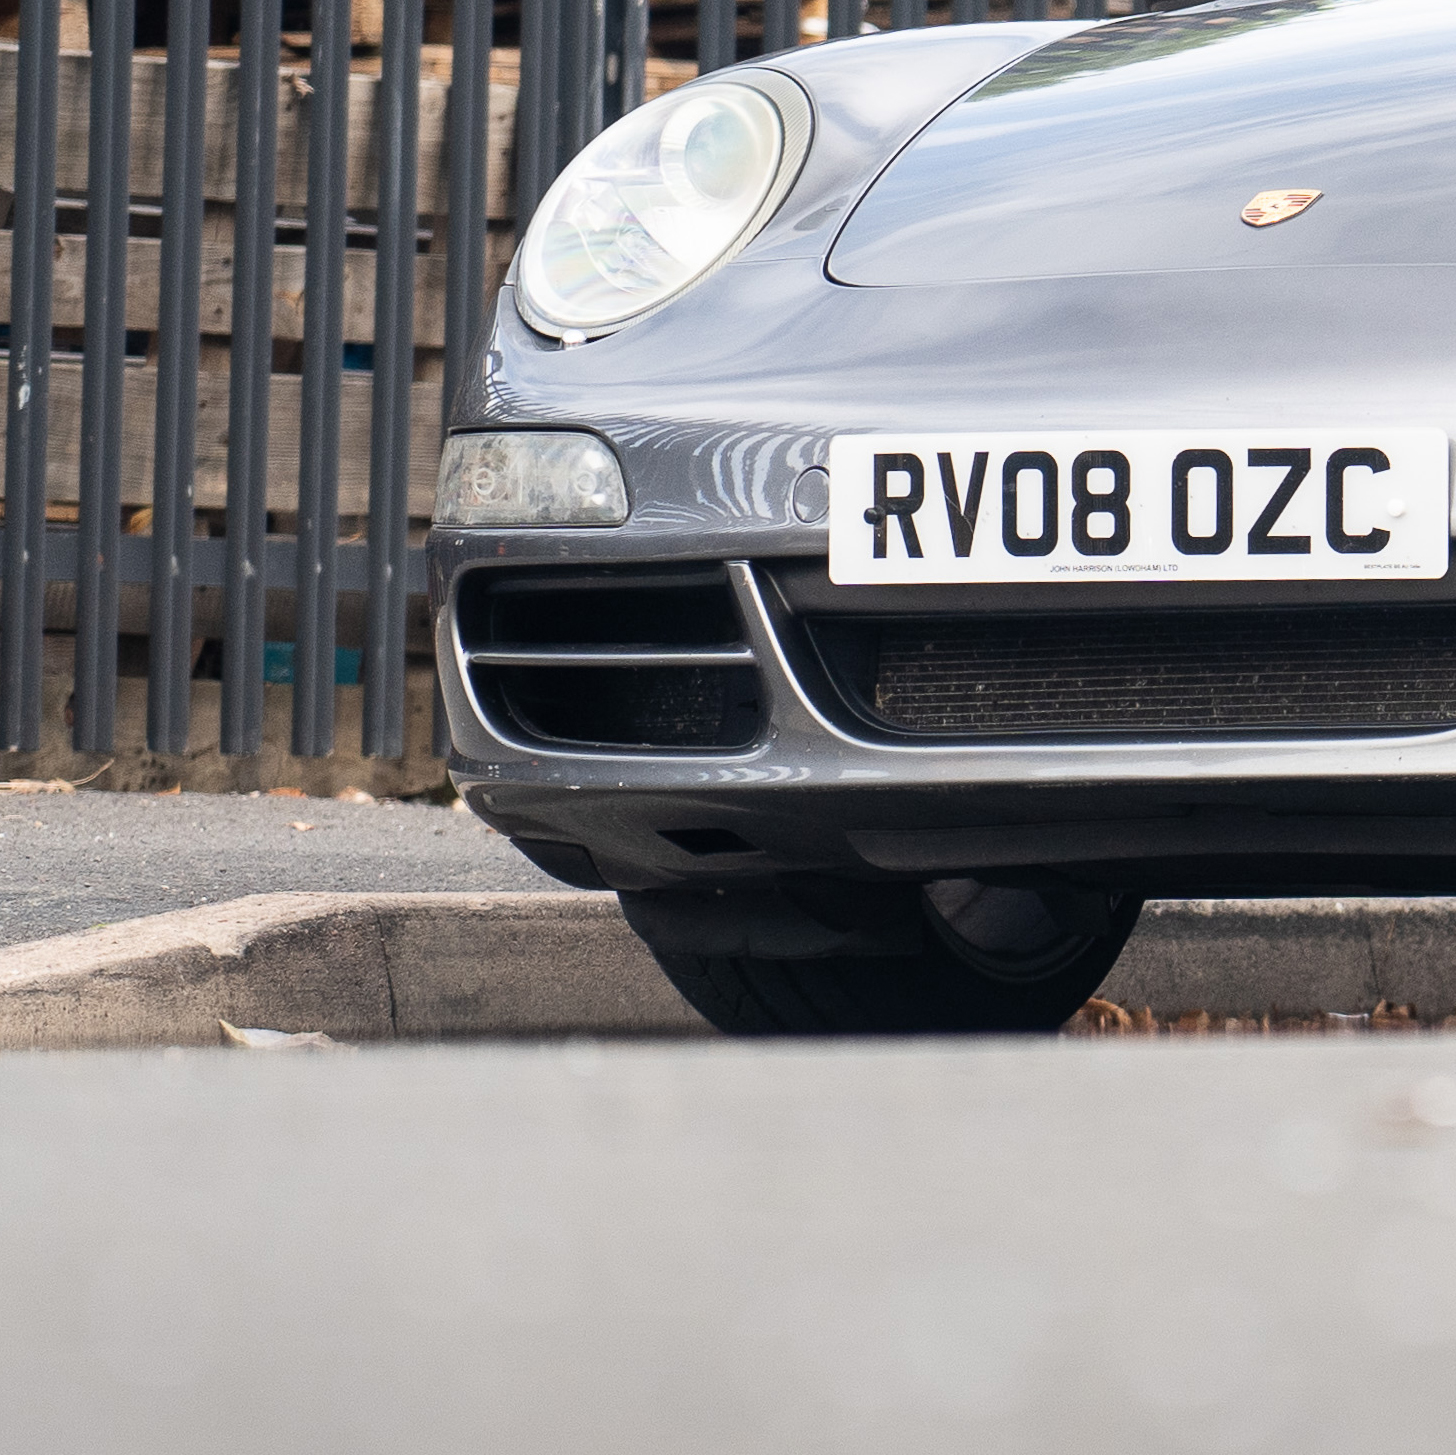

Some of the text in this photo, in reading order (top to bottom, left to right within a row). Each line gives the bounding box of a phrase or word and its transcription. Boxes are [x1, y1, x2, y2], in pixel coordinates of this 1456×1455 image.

[871, 447, 1391, 558] RV08 OZC
[1049, 564, 1071, 573] JOHN
[1072, 564, 1113, 573] HARRISON
[1162, 563, 1179, 572] LTD
